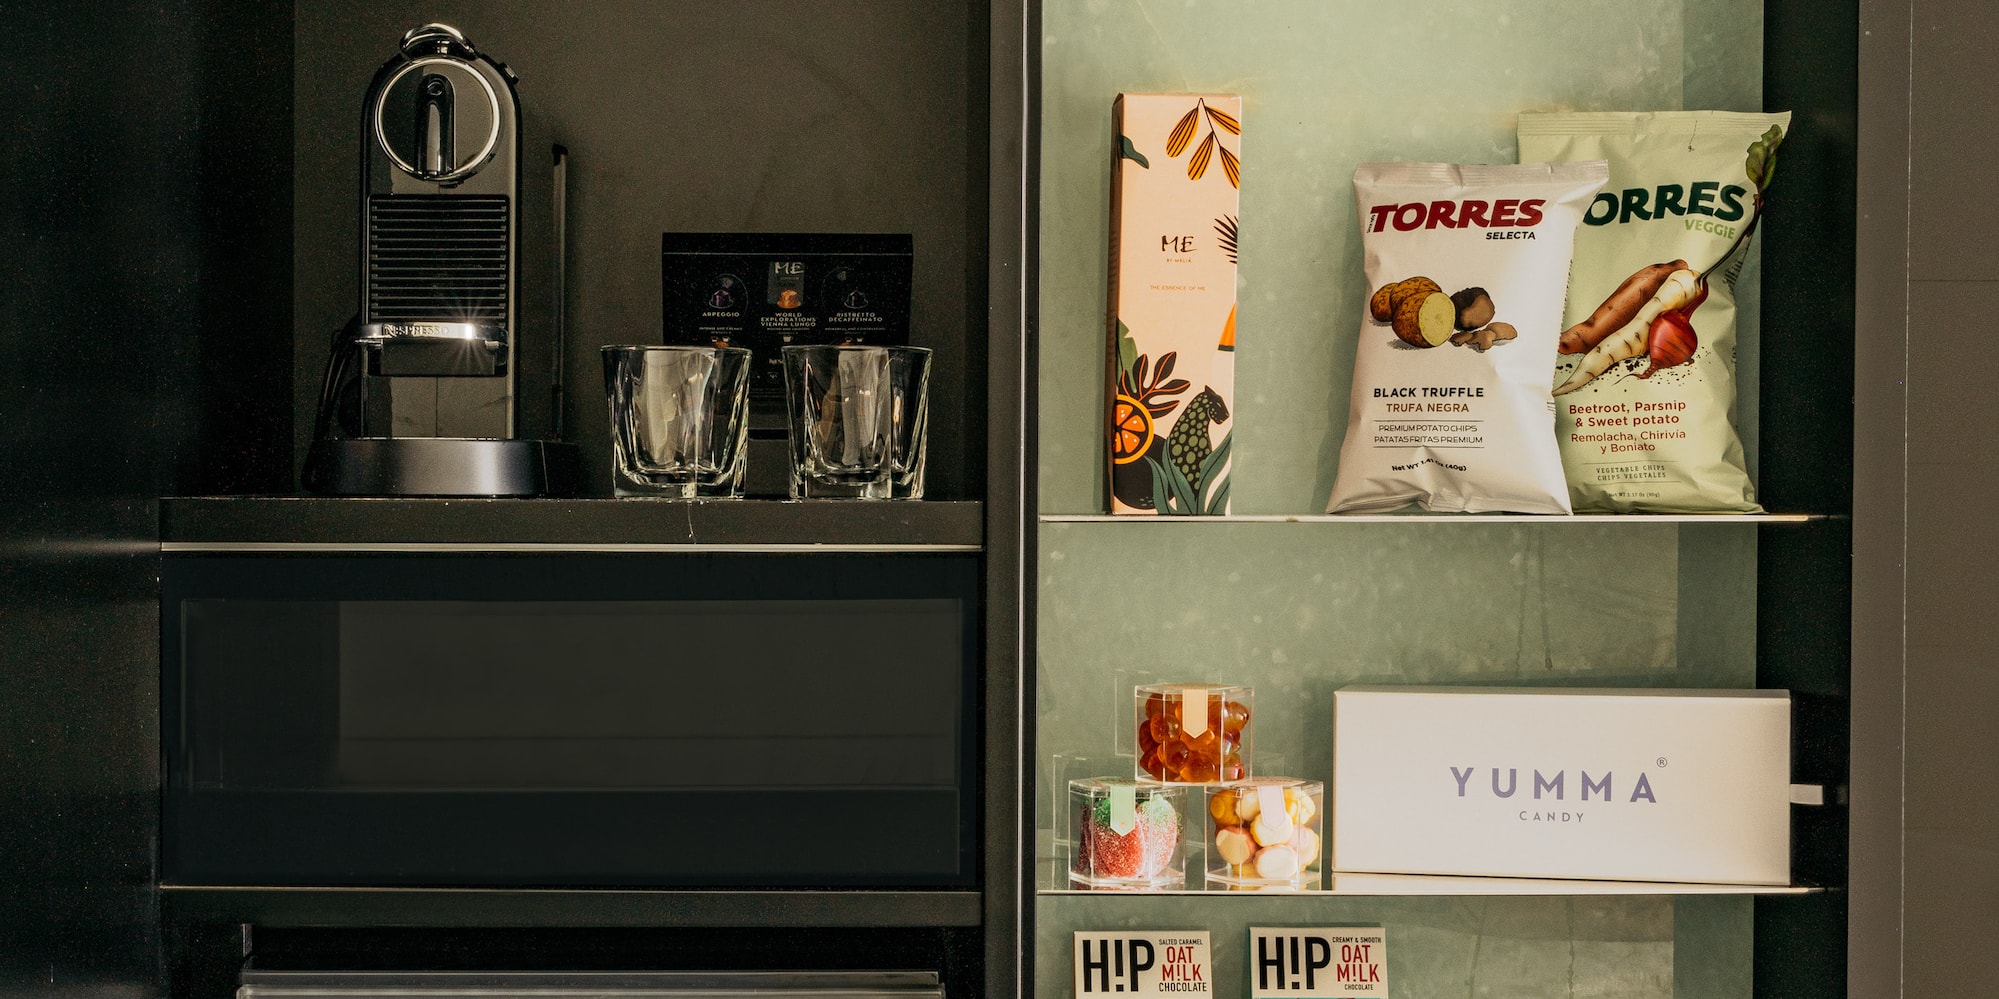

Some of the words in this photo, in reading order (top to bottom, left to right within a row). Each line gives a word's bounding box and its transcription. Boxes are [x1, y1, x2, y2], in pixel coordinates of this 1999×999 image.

[1583, 181, 1748, 226] ORRES
[1369, 199, 1547, 233] TORRES
[1485, 230, 1536, 240] SELECTA
[1161, 234, 1198, 253] ME
[774, 261, 805, 275] ME
[384, 323, 449, 337] NESPRESSO
[1373, 387, 1417, 398] BLACK
[1422, 387, 1484, 397] TRUFFLE
[1386, 403, 1423, 412] TRUFA
[1427, 403, 1469, 412] NEGRA
[1569, 402, 1630, 414] Beetroot,
[1635, 400, 1686, 412] Parsnip
[1378, 424, 1415, 432] PREMIUM
[1416, 424, 1450, 432] POTATO
[1575, 418, 1583, 427] &
[1588, 416, 1628, 427] Sweet
[1633, 414, 1680, 428] potato
[1571, 432, 1637, 443] Remolacha,
[1600, 445, 1607, 454] y
[1611, 443, 1656, 453] Boniato
[1450, 766, 1657, 803] YUMMA
[1519, 811, 1584, 823] CANDY
[1166, 946, 1194, 963] OAT
[1341, 944, 1371, 963] OAT
[1082, 939, 1155, 992] H!P
[1258, 936, 1331, 990] H!P
[1162, 964, 1203, 981] M!LK
[1336, 963, 1380, 982] M!LK
[1158, 982, 1207, 992] CHOCOLATE
